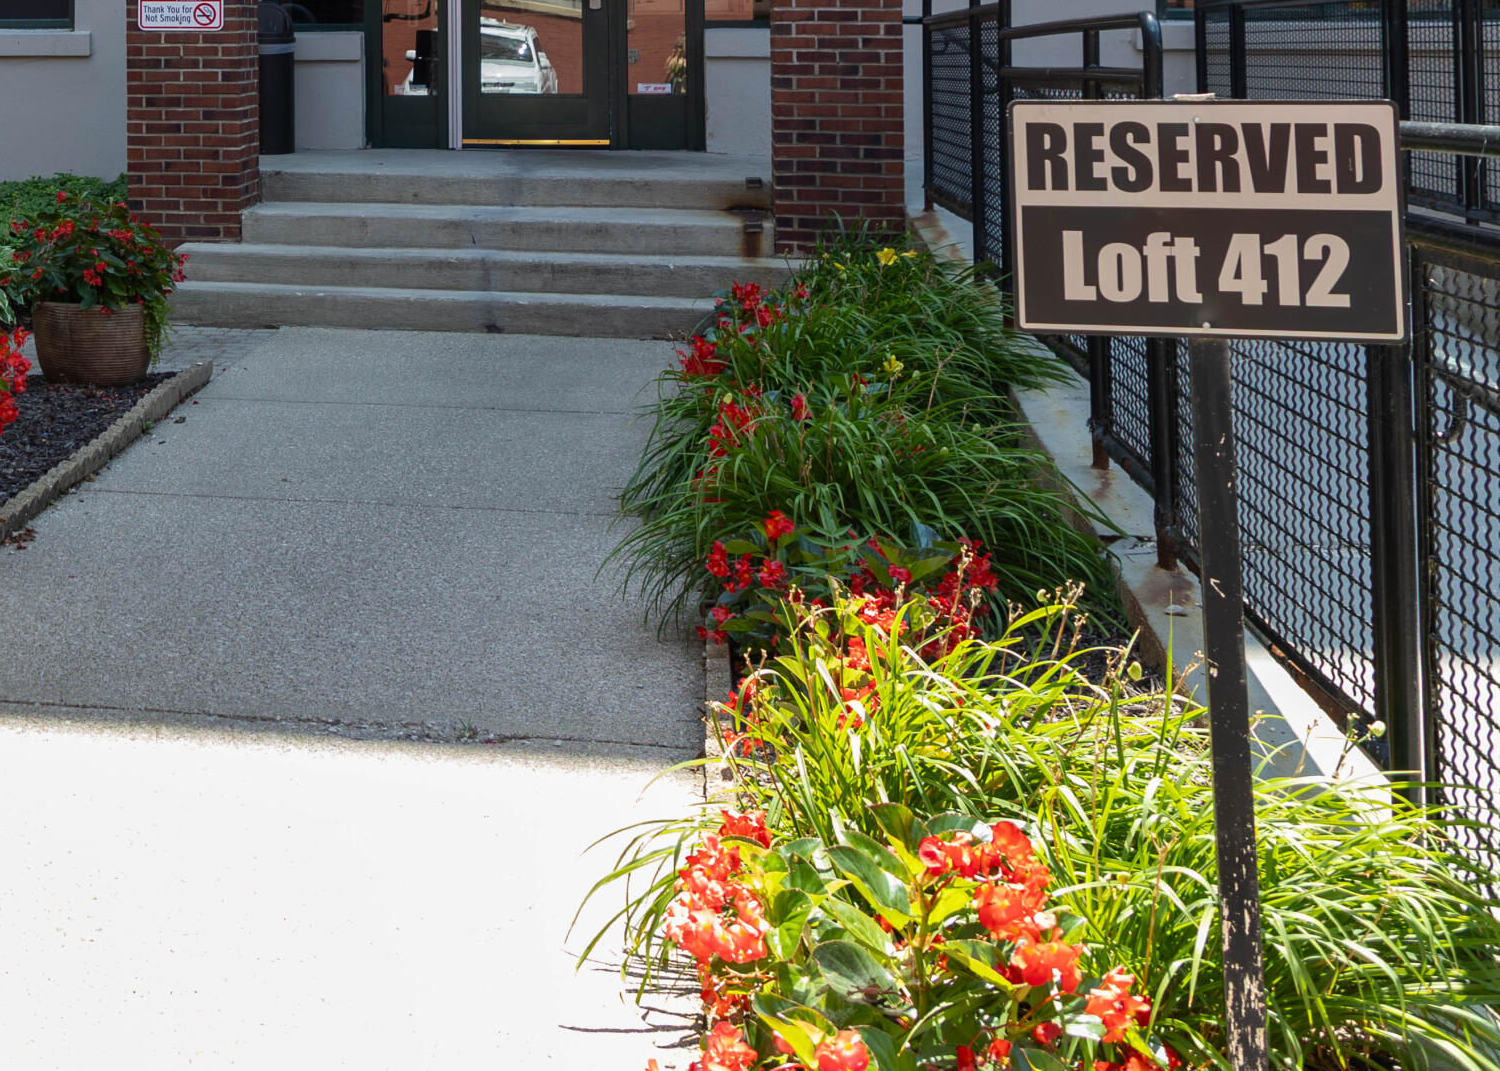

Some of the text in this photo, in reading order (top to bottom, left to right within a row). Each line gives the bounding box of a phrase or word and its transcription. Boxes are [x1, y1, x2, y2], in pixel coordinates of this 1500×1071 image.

[143, 5, 193, 14] Thank You for
[145, 15, 191, 24] Not Smoking
[1025, 120, 1383, 195] RESERVED
[1062, 230, 1352, 308] Loft 412
